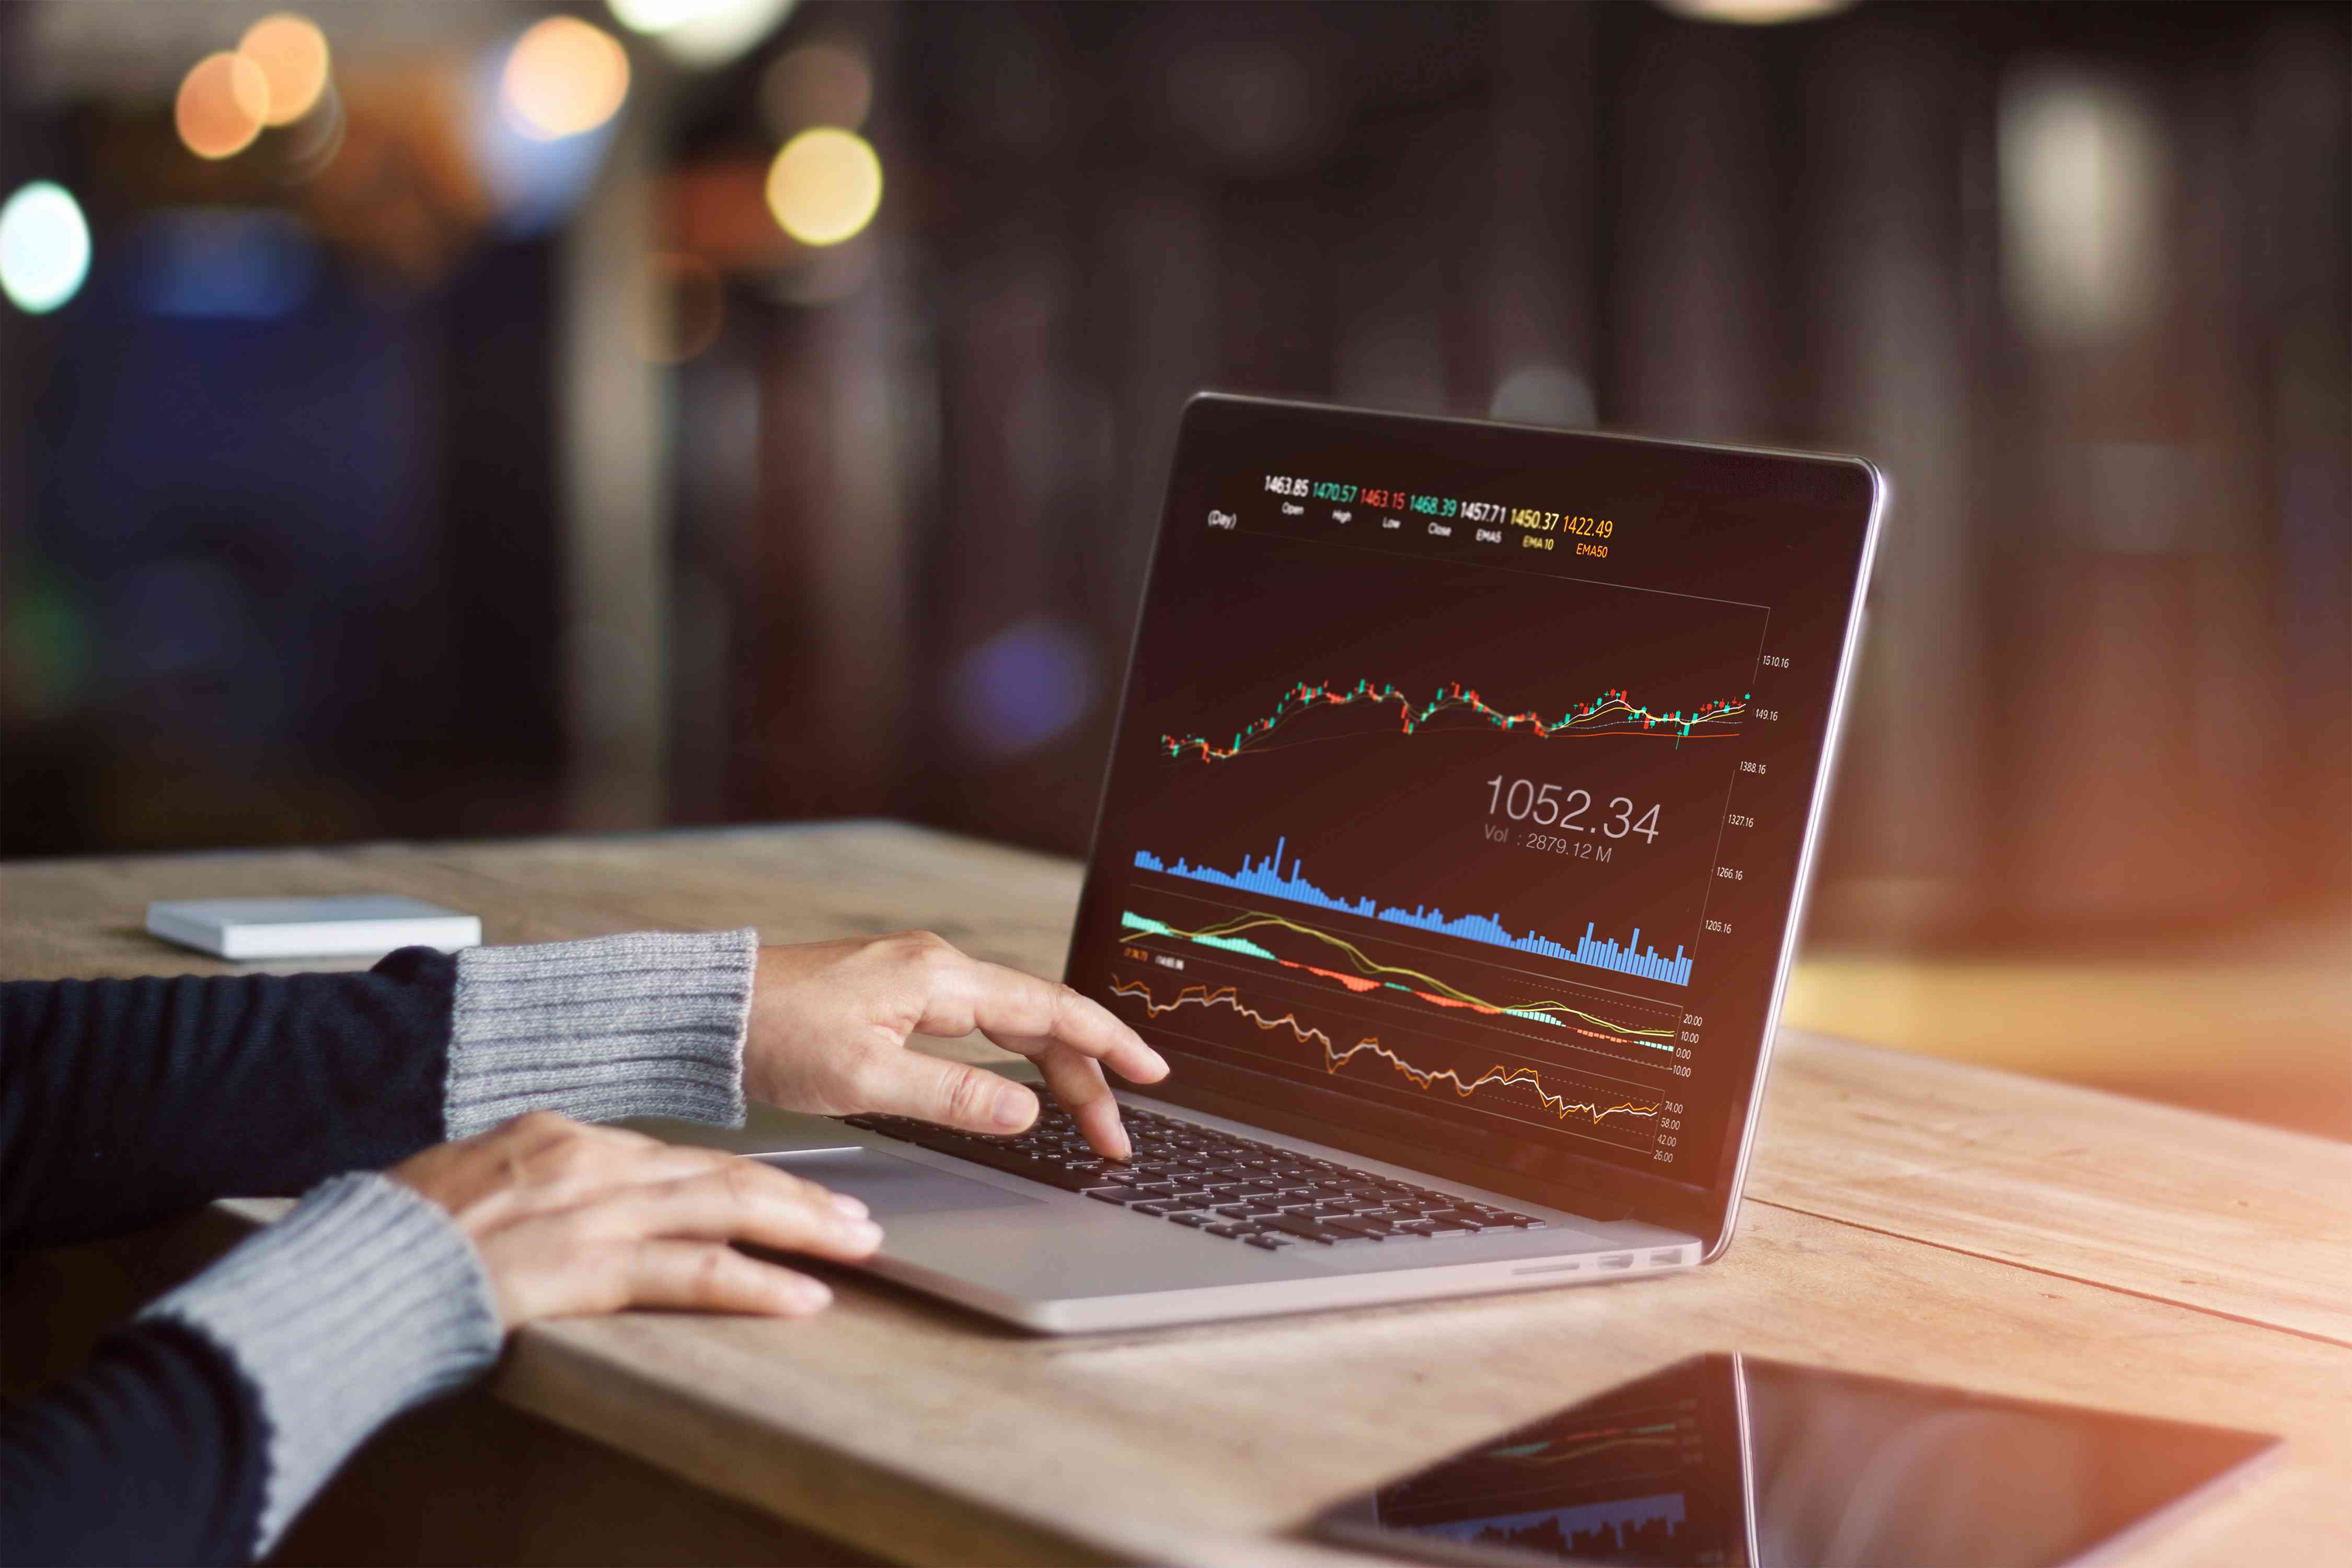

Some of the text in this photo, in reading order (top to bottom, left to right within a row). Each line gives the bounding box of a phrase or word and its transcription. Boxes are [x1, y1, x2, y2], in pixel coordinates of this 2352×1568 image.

[1265, 476, 1612, 538] 1463.85 1470.57 1463.15 1468.39 1457.71 1450.37 1422.49
[1208, 510, 1236, 529] (Day)
[1282, 502, 1304, 514] Open
[1333, 511, 1351, 523] High
[1383, 518, 1400, 528] Low
[1428, 523, 1451, 536] Close
[1576, 543, 1608, 558] EMA50
[1763, 655, 1789, 668] 1510.16
[1740, 762, 1766, 774] 1388.16
[1486, 775, 1661, 845] 1052.34
[1728, 814, 1754, 827] 1327.16
[1485, 824, 1508, 843] Vol
[1526, 833, 1593, 860] 2879.12
[1596, 846, 1611, 862] M
[1717, 867, 1743, 880] 1266.16
[1706, 920, 1731, 933] 1205.16
[1684, 1014, 1702, 1026] 20.00
[1681, 1031, 1699, 1043] 10.00
[1676, 1048, 1691, 1059] 0.00
[1665, 1101, 1682, 1114] 74.00
[1661, 1117, 1680, 1130] 58.00
[1657, 1135, 1676, 1147] 42.00
[1654, 1150, 1673, 1162] 26.00
